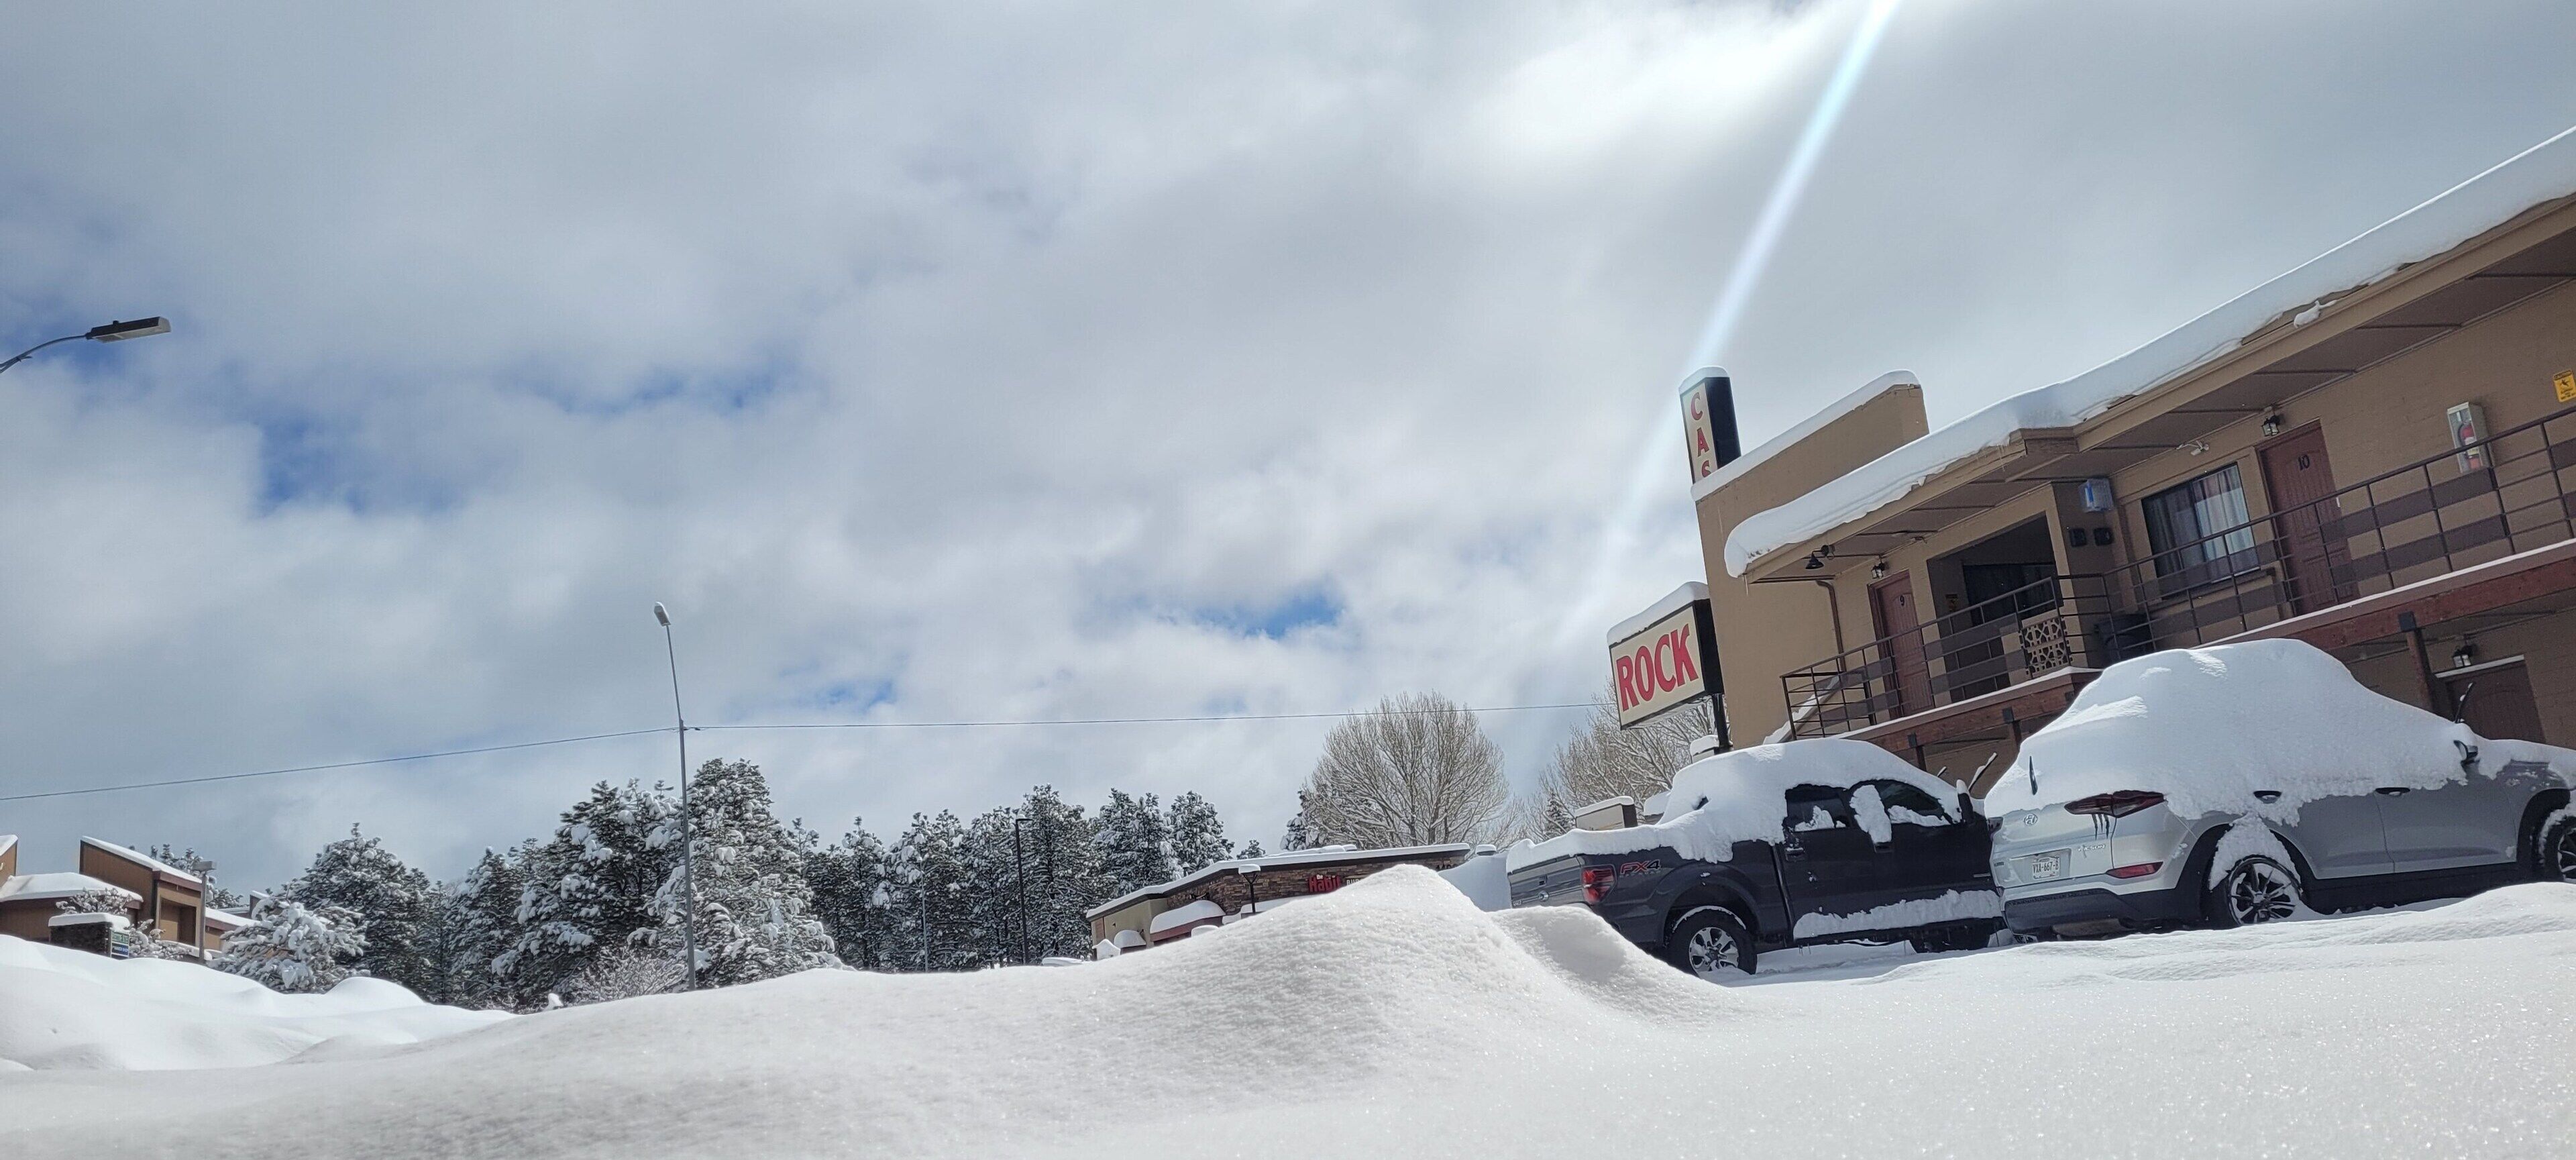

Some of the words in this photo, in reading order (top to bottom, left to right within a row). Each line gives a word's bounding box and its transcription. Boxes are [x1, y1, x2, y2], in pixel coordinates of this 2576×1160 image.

[2298, 454, 2310, 470] 10
[1899, 595, 1905, 607] 9
[1616, 623, 1699, 712] ROCK
[1620, 859, 1661, 874] FX4
